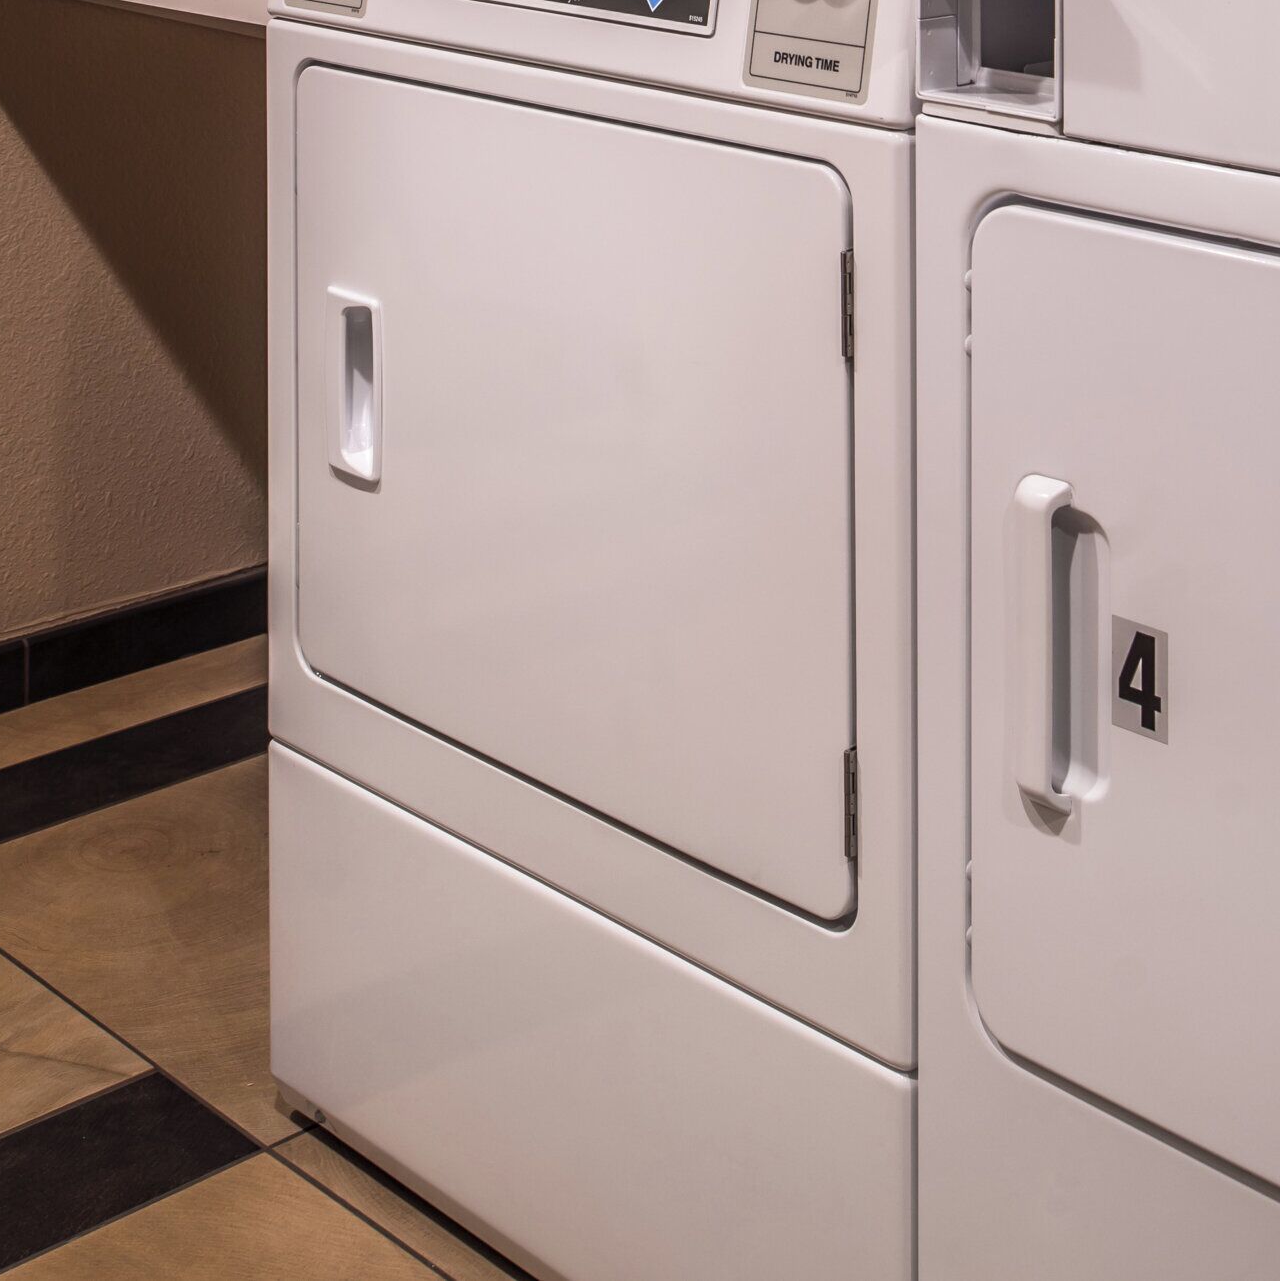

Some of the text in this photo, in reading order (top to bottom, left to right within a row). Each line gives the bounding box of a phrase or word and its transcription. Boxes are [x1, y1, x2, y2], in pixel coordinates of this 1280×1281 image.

[774, 51, 840, 73] DRYING TIME
[1119, 631, 1161, 731] 4
